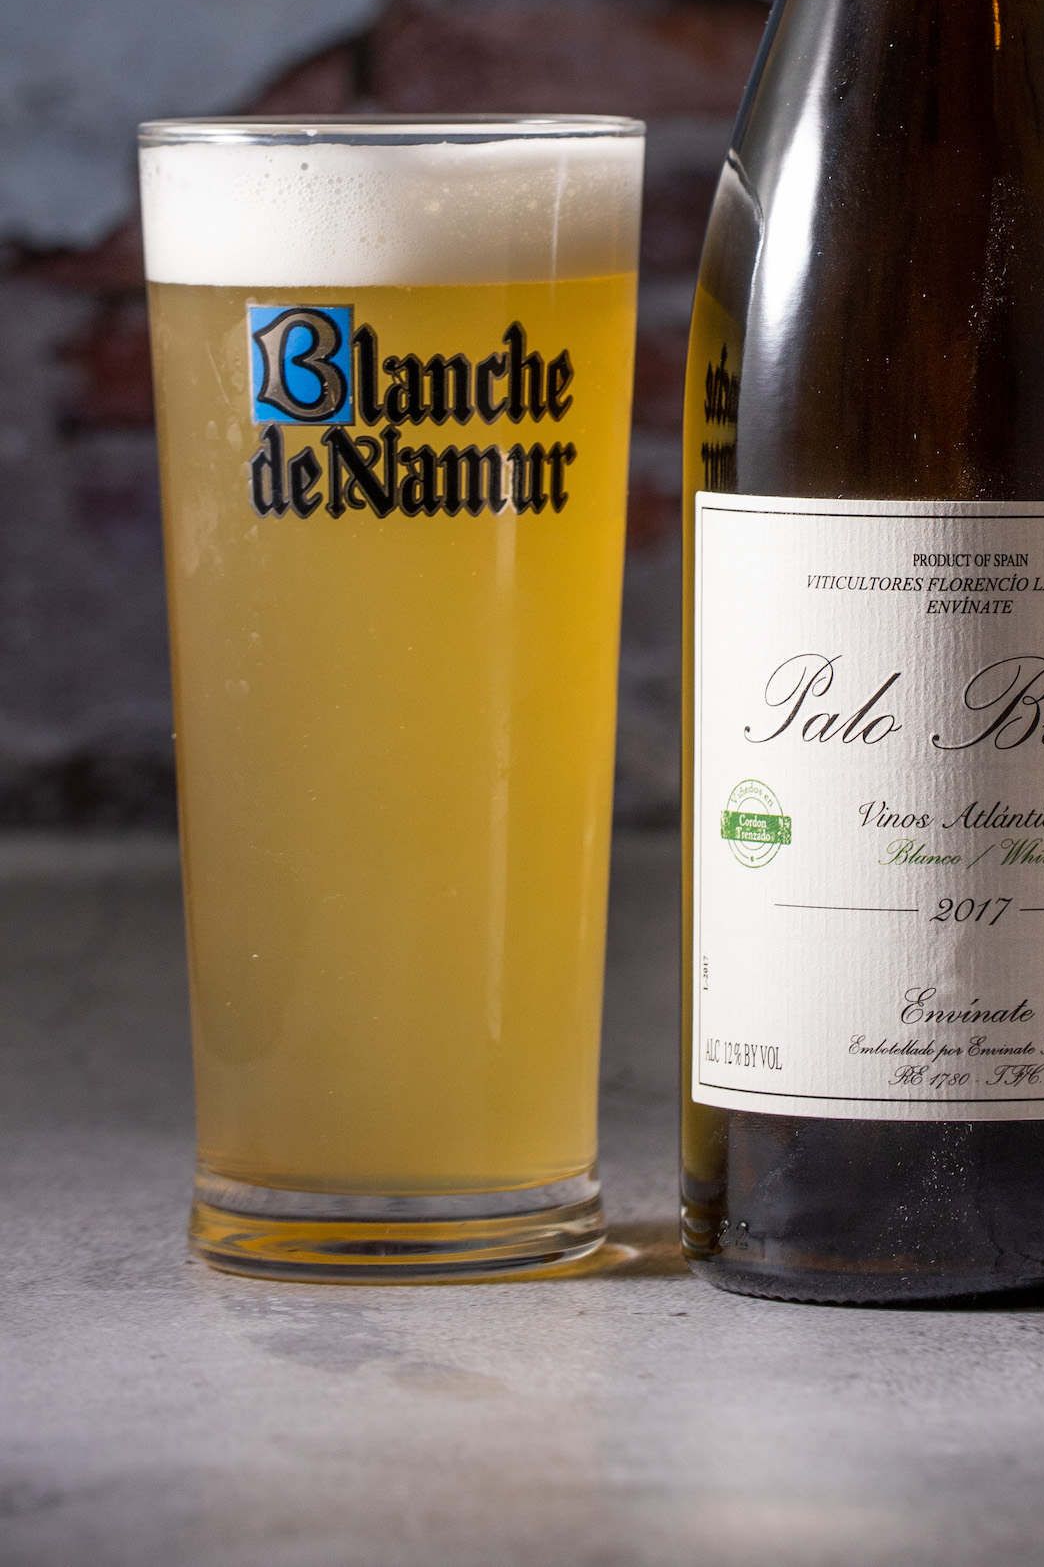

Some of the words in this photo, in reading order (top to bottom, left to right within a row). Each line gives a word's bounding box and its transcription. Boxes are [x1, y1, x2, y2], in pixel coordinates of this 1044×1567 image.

[250, 306, 574, 426] Blanche
[249, 421, 324, 519] de
[322, 424, 576, 519] Namur
[913, 554, 971, 567] PRODUCT
[975, 554, 991, 567] OF
[994, 554, 1029, 567] SPAIN
[806, 574, 923, 592] VITICULTORES
[927, 574, 1029, 591] FLORENCÍO
[926, 597, 1013, 614] ENVÍNATE
[744, 652, 902, 744] Palo
[731, 782, 763, 804] Viñedos
[764, 794, 774, 808] en
[739, 814, 767, 828] Cordon
[858, 800, 935, 829] Vinos
[735, 826, 771, 841] Trenzado
[878, 837, 962, 866] Blanco
[930, 897, 1013, 926] 2017
[900, 987, 1036, 1025] Envínate
[705, 1038, 720, 1063] ALC
[744, 1043, 758, 1068] BY
[760, 1045, 783, 1070] VOL
[848, 1034, 937, 1056] Embotellado
[932, 1044, 964, 1063] por
[929, 1073, 970, 1089] 1780
